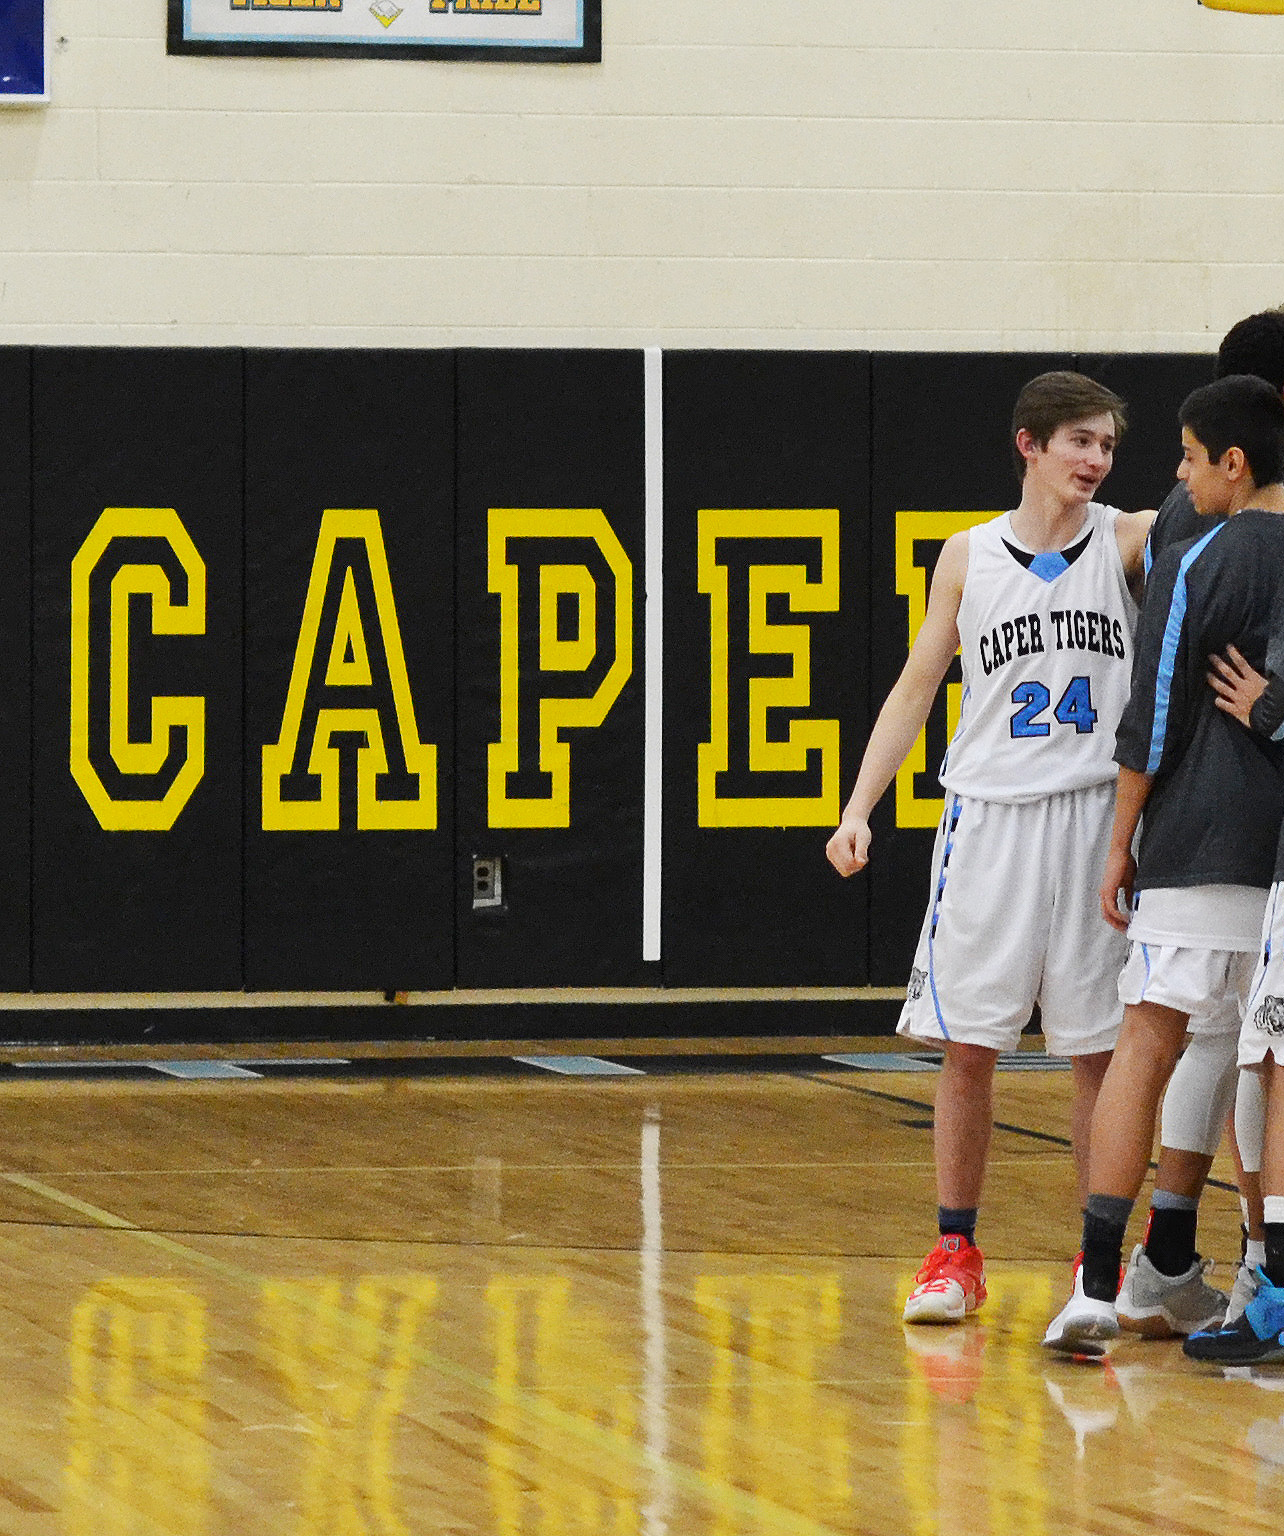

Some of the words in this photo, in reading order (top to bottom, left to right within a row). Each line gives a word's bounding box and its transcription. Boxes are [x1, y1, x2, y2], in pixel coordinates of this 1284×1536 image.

[979, 612, 1046, 676] CAPER
[1050, 609, 1126, 660] TIGERS
[1010, 676, 1098, 738] 24
